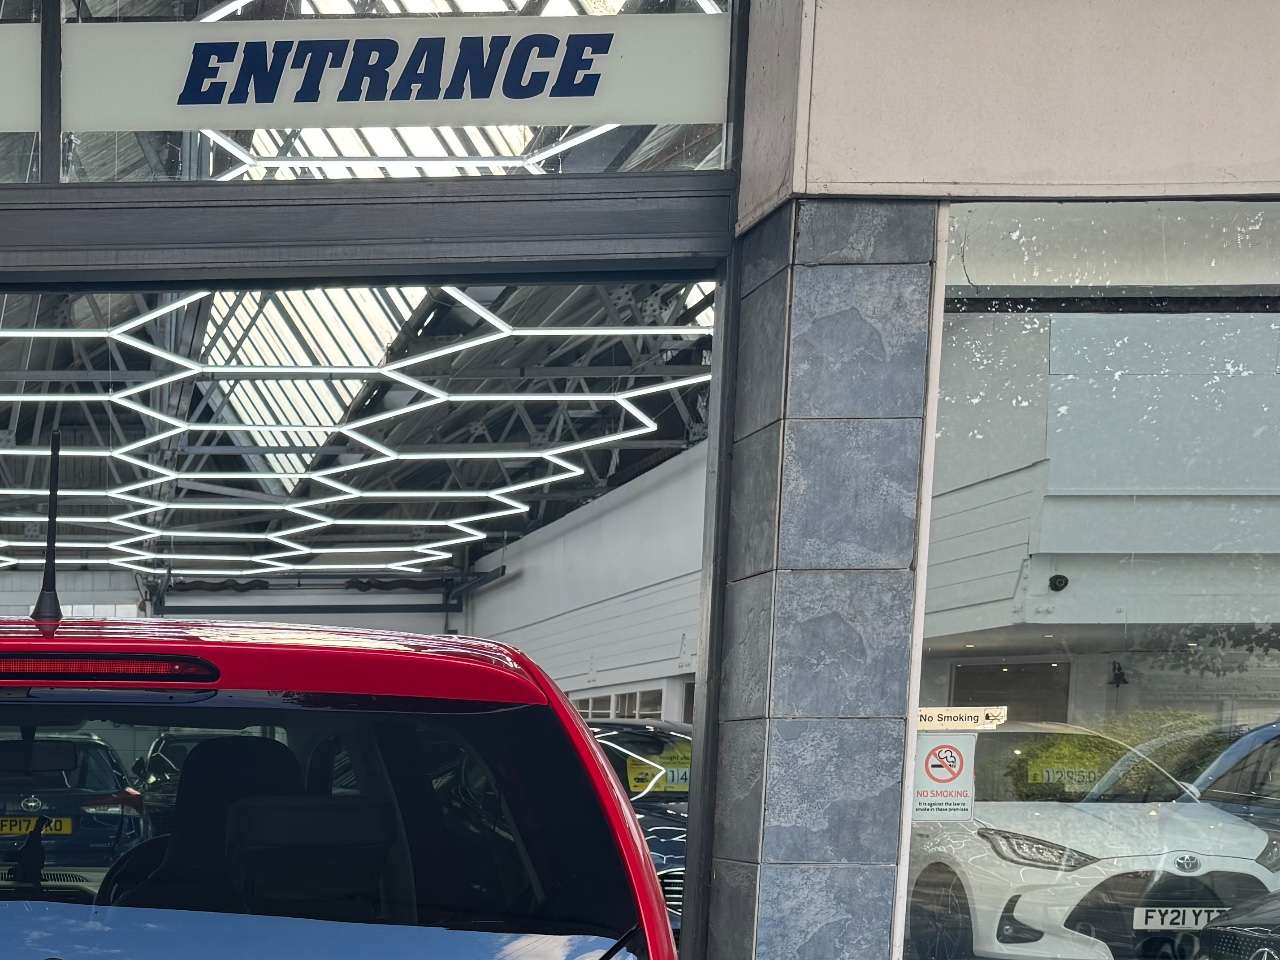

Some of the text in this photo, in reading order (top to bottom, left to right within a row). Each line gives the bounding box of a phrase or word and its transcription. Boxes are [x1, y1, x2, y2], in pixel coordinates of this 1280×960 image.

[176, 32, 615, 106] ENTRANCE
[919, 713, 980, 723] No Smoking
[669, 769, 689, 783] 14
[916, 790, 929, 798] NO
[0, 819, 31, 833] FP17
[1144, 909, 1227, 926] FY21 YT
